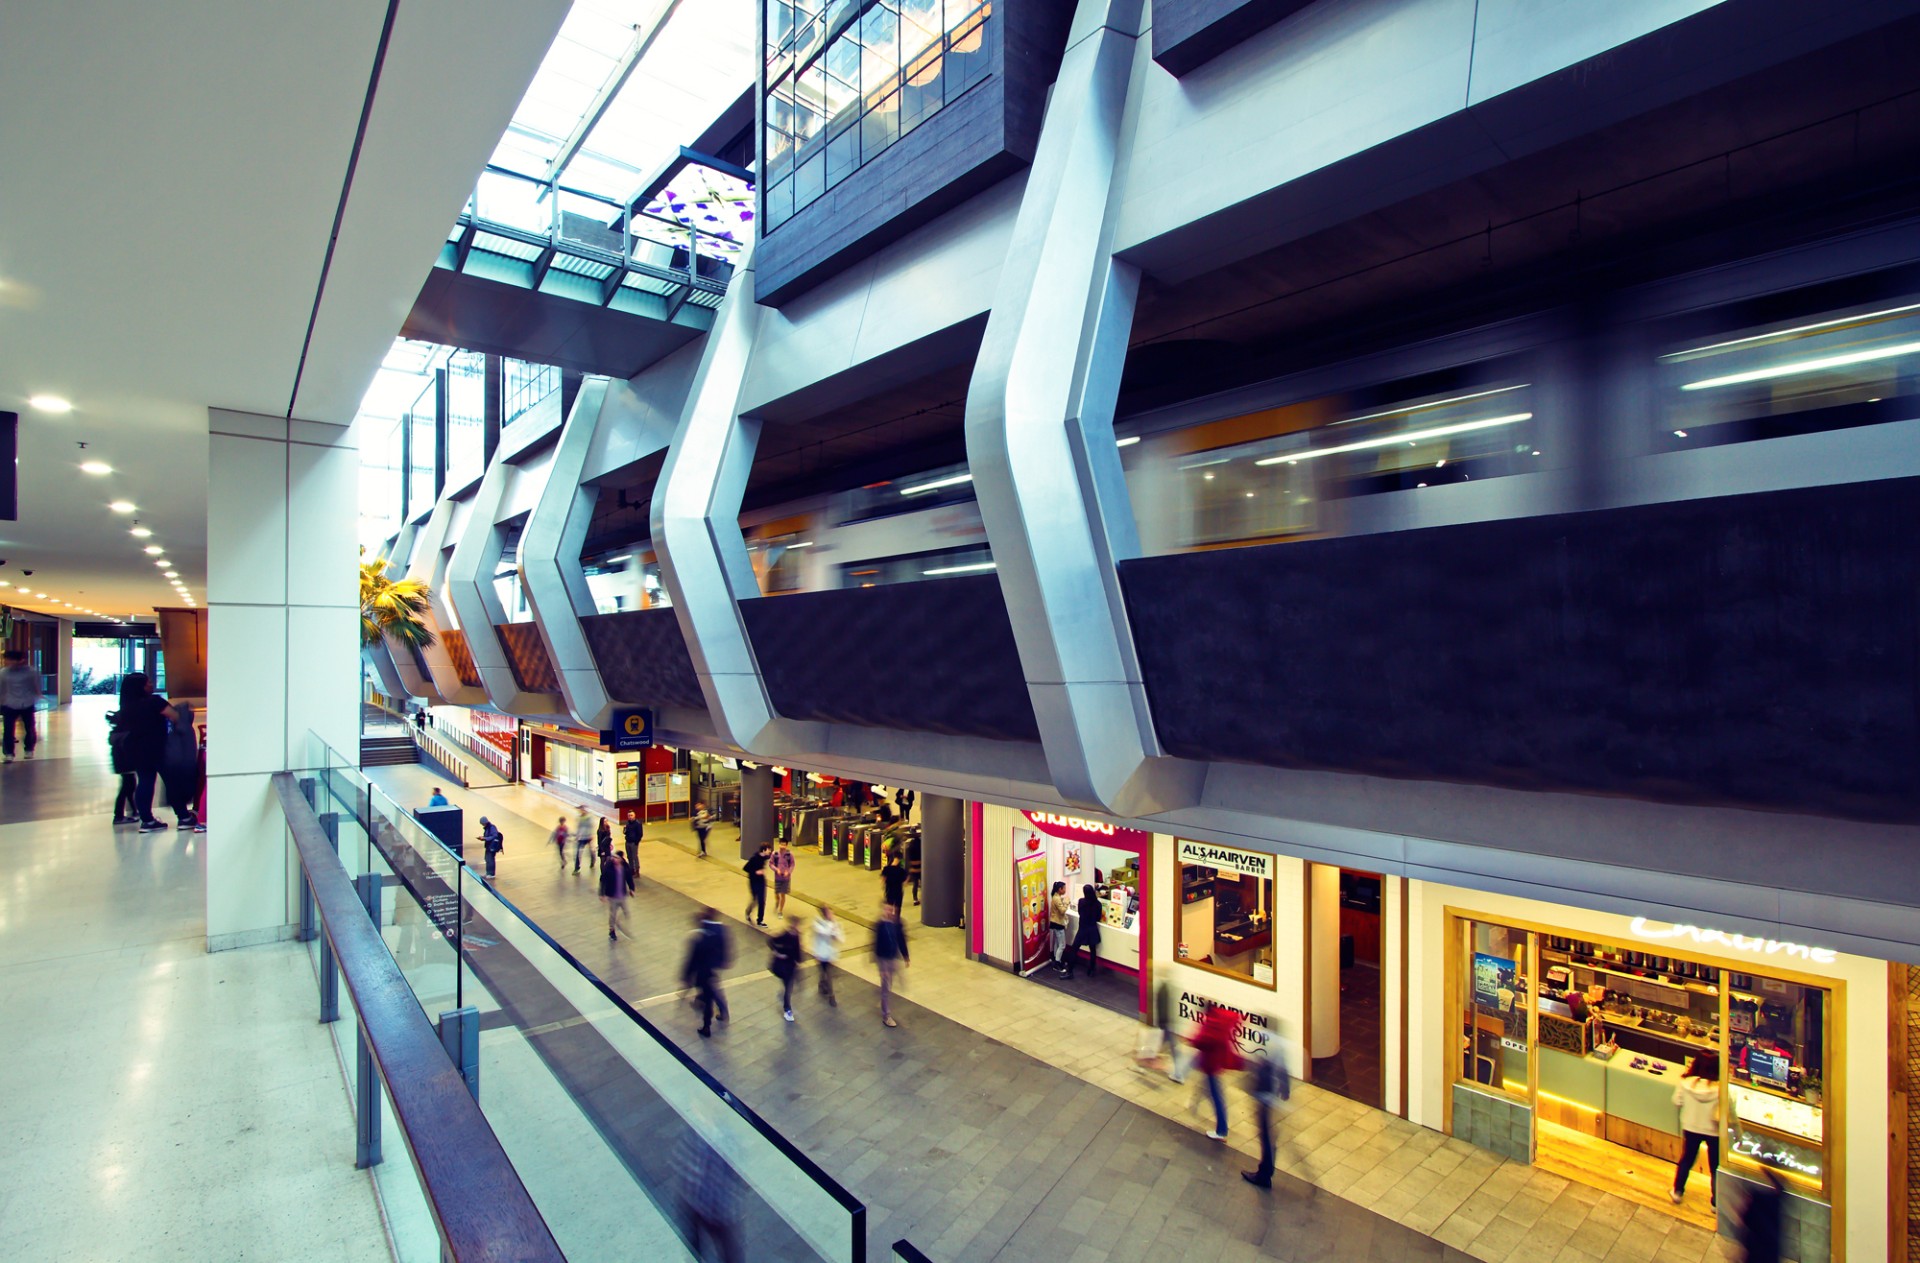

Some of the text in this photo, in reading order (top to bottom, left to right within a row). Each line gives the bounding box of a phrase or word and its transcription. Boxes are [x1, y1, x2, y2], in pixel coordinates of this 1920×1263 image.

[619, 739, 650, 747] Chatswood
[1183, 844, 1266, 869] AL'S HAIRVEN
[1234, 863, 1266, 875] BARBER
[1181, 991, 1205, 1008] AL'S
[1233, 1021, 1270, 1046] SHOP
[1732, 1139, 1820, 1175] Chatime
